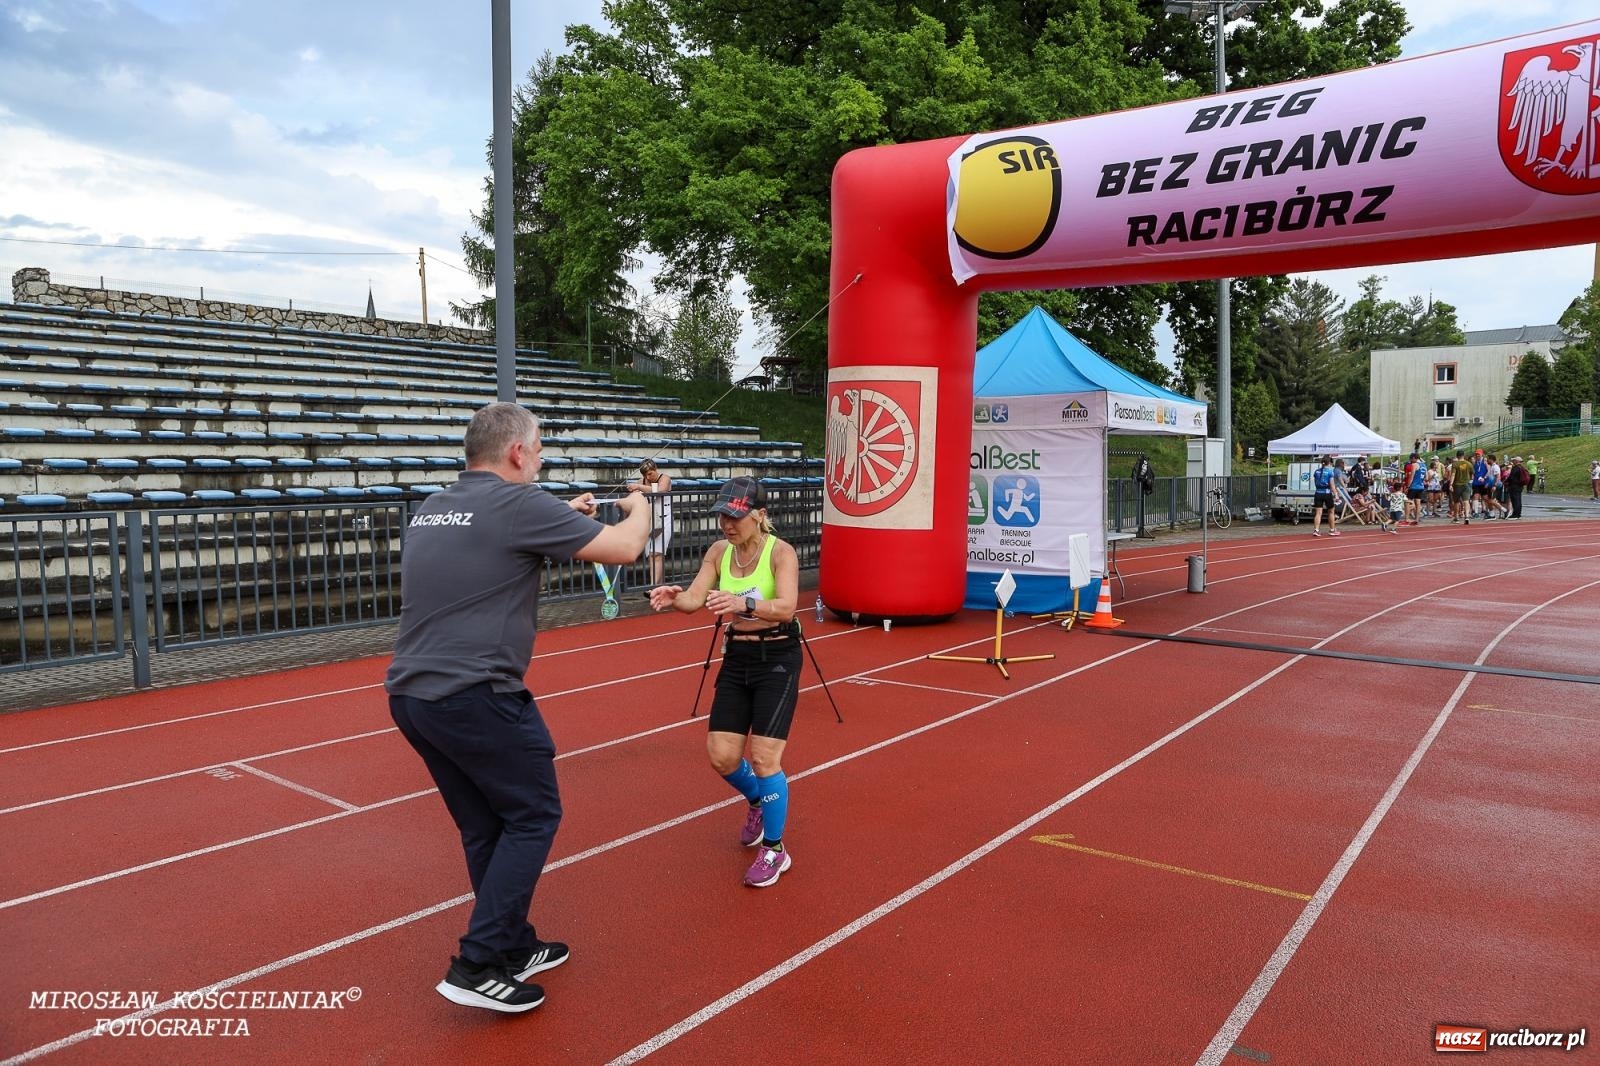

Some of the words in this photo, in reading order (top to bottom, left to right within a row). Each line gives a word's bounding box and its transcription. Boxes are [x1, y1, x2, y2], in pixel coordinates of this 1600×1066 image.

[1185, 87, 1326, 134] BIEG
[998, 146, 1059, 174] SIR
[1096, 152, 1199, 198] BEZ
[1206, 116, 1426, 184] GRANIC
[1127, 185, 1395, 247] RACIBÓRZ
[1062, 410, 1089, 419] MITKO
[1114, 402, 1156, 421] PersonalBest
[408, 510, 474, 528] RACIBÓRZ
[1000, 539, 1032, 547] BIEGOWE
[1001, 529, 1031, 538] TRENINGI
